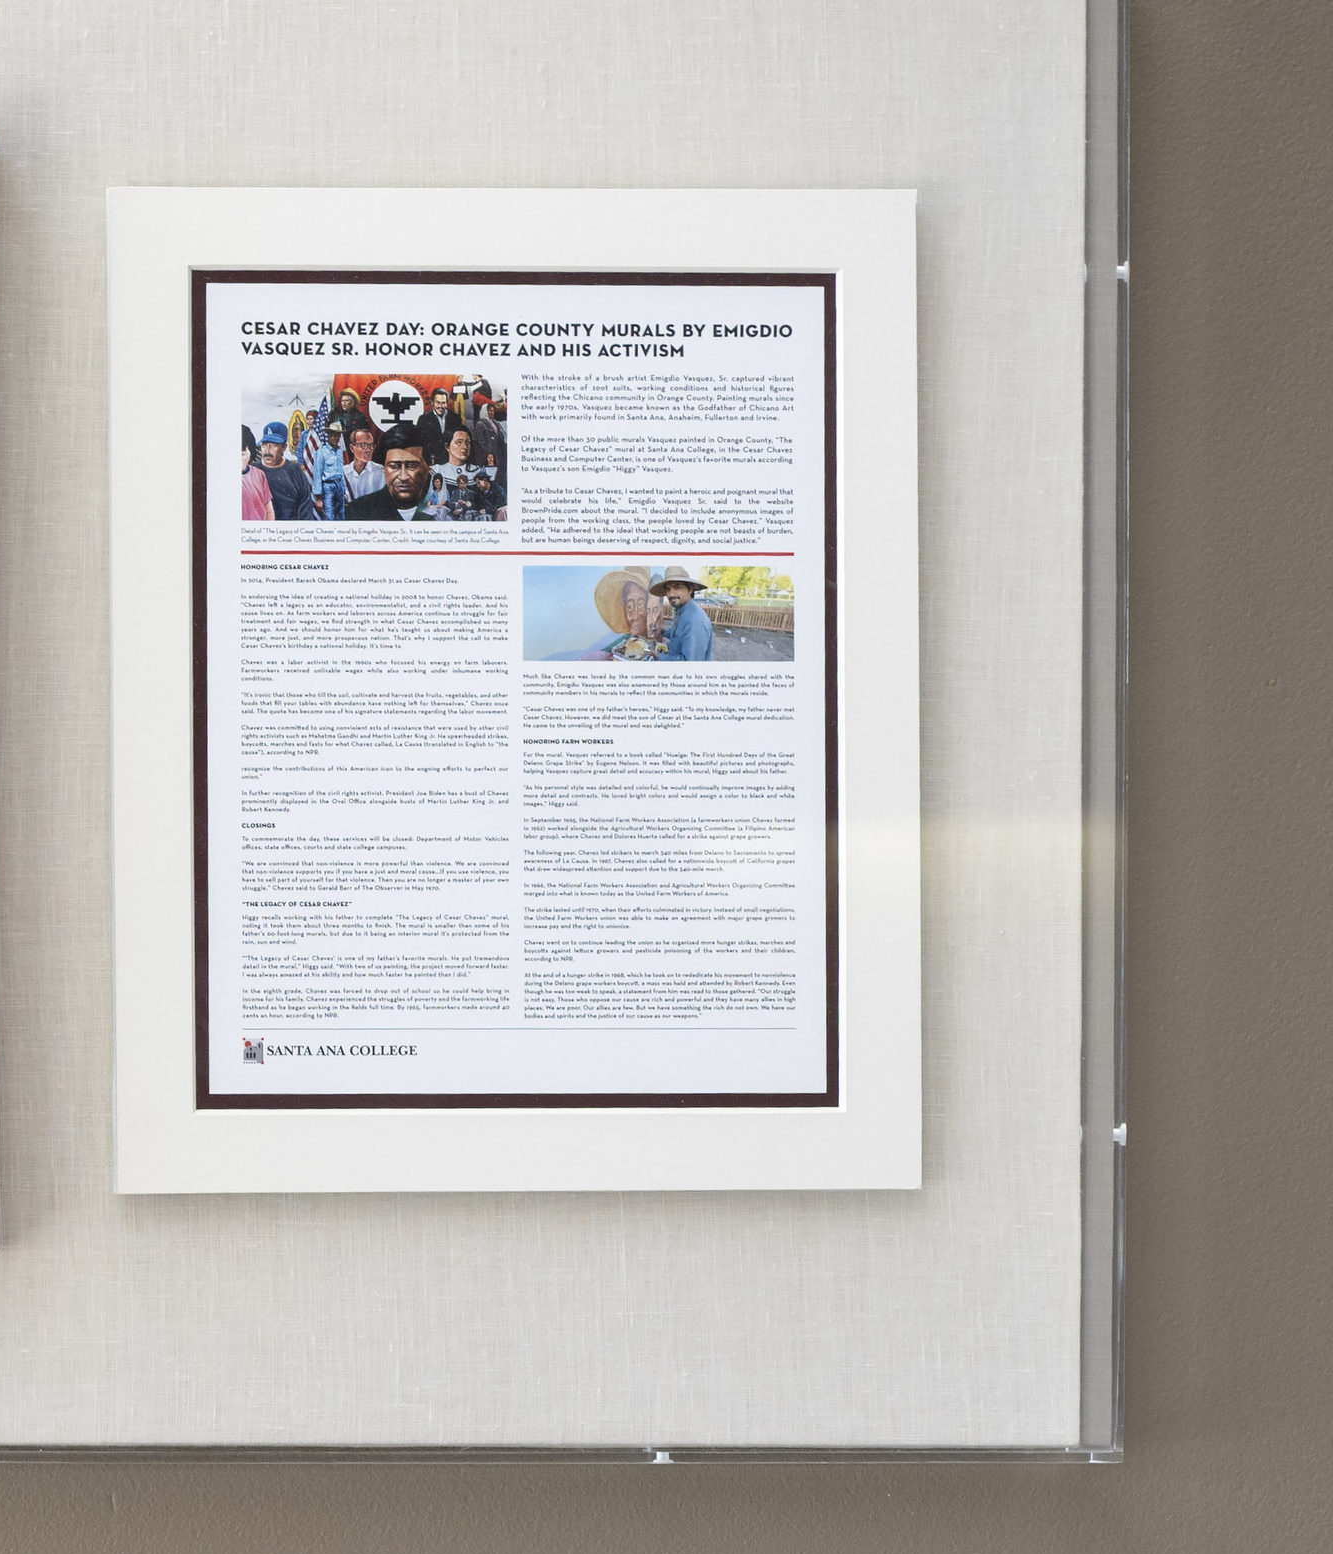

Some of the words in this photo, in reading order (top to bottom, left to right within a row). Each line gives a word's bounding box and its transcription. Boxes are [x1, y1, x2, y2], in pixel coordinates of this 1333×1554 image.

[241, 321, 301, 336] CESAR
[307, 322, 379, 336] CHAVEZ
[386, 322, 424, 336] DAY:
[431, 322, 509, 336] ORANGE
[516, 323, 595, 337] COUNTY
[601, 323, 676, 338] MURALS
[683, 324, 706, 338] BY
[713, 324, 793, 338] EMIGDIO
[241, 341, 325, 356] VASQUEZ
[331, 342, 359, 356] SR.
[365, 342, 433, 356] HONOR
[439, 342, 511, 357] CHAVEZ
[517, 343, 556, 357] AND
[562, 343, 592, 357] HIS
[597, 343, 684, 358] ACTIVISM
[521, 373, 539, 382] With
[542, 373, 555, 382] the
[557, 373, 581, 382] stroke
[584, 373, 593, 382] of
[603, 374, 624, 382] brush
[627, 374, 647, 382] artist
[650, 374, 680, 384] Emigdio
[731, 375, 765, 384] captured
[521, 383, 576, 392] characteristics
[579, 383, 588, 392] of
[592, 383, 609, 392] zoot
[636, 384, 666, 394] working
[669, 384, 709, 392] conditions
[713, 384, 727, 392] and
[730, 384, 765, 392] historical
[769, 384, 795, 394] figures
[521, 393, 557, 403] reflecting
[558, 393, 571, 401] the
[572, 393, 604, 401] Chicano
[605, 393, 646, 403] community
[656, 394, 685, 403] Orange
[716, 394, 747, 404] Painting
[748, 394, 773, 402] murals
[775, 394, 795, 402] since
[521, 402, 533, 410] the
[535, 403, 555, 412] early
[581, 403, 612, 413] Vasquez
[614, 403, 644, 411] became
[646, 403, 670, 411] known
[683, 403, 695, 411] the
[697, 404, 737, 412] Godfather
[738, 404, 747, 412] of
[749, 404, 780, 412] Chicano
[782, 404, 794, 412] Art
[559, 413, 593, 422] primarily
[594, 413, 616, 421] found
[617, 413, 625, 421] in
[626, 413, 648, 421] Santa
[704, 414, 739, 422] Fullerton
[740, 414, 754, 422] and
[521, 434, 531, 443] Of
[533, 434, 545, 443] the
[567, 435, 584, 443] than
[585, 435, 596, 443] 30
[597, 435, 620, 445] public
[621, 435, 645, 443] murals
[647, 435, 677, 445] Vasquez
[678, 436, 707, 445] painted
[716, 436, 744, 445] Orange
[521, 445, 547, 455] Legacy
[548, 445, 557, 453] of
[558, 445, 580, 453] Cesar
[615, 445, 635, 453] mural
[637, 445, 645, 453] at
[647, 445, 668, 453] Santa
[719, 446, 726, 454] in
[728, 446, 741, 454] the
[742, 446, 764, 454] Cesar
[766, 446, 793, 454] Chavez
[267, 1045, 313, 1056] SANTA
[316, 1045, 346, 1056] ANA
[349, 1045, 418, 1056] COLLEGE
